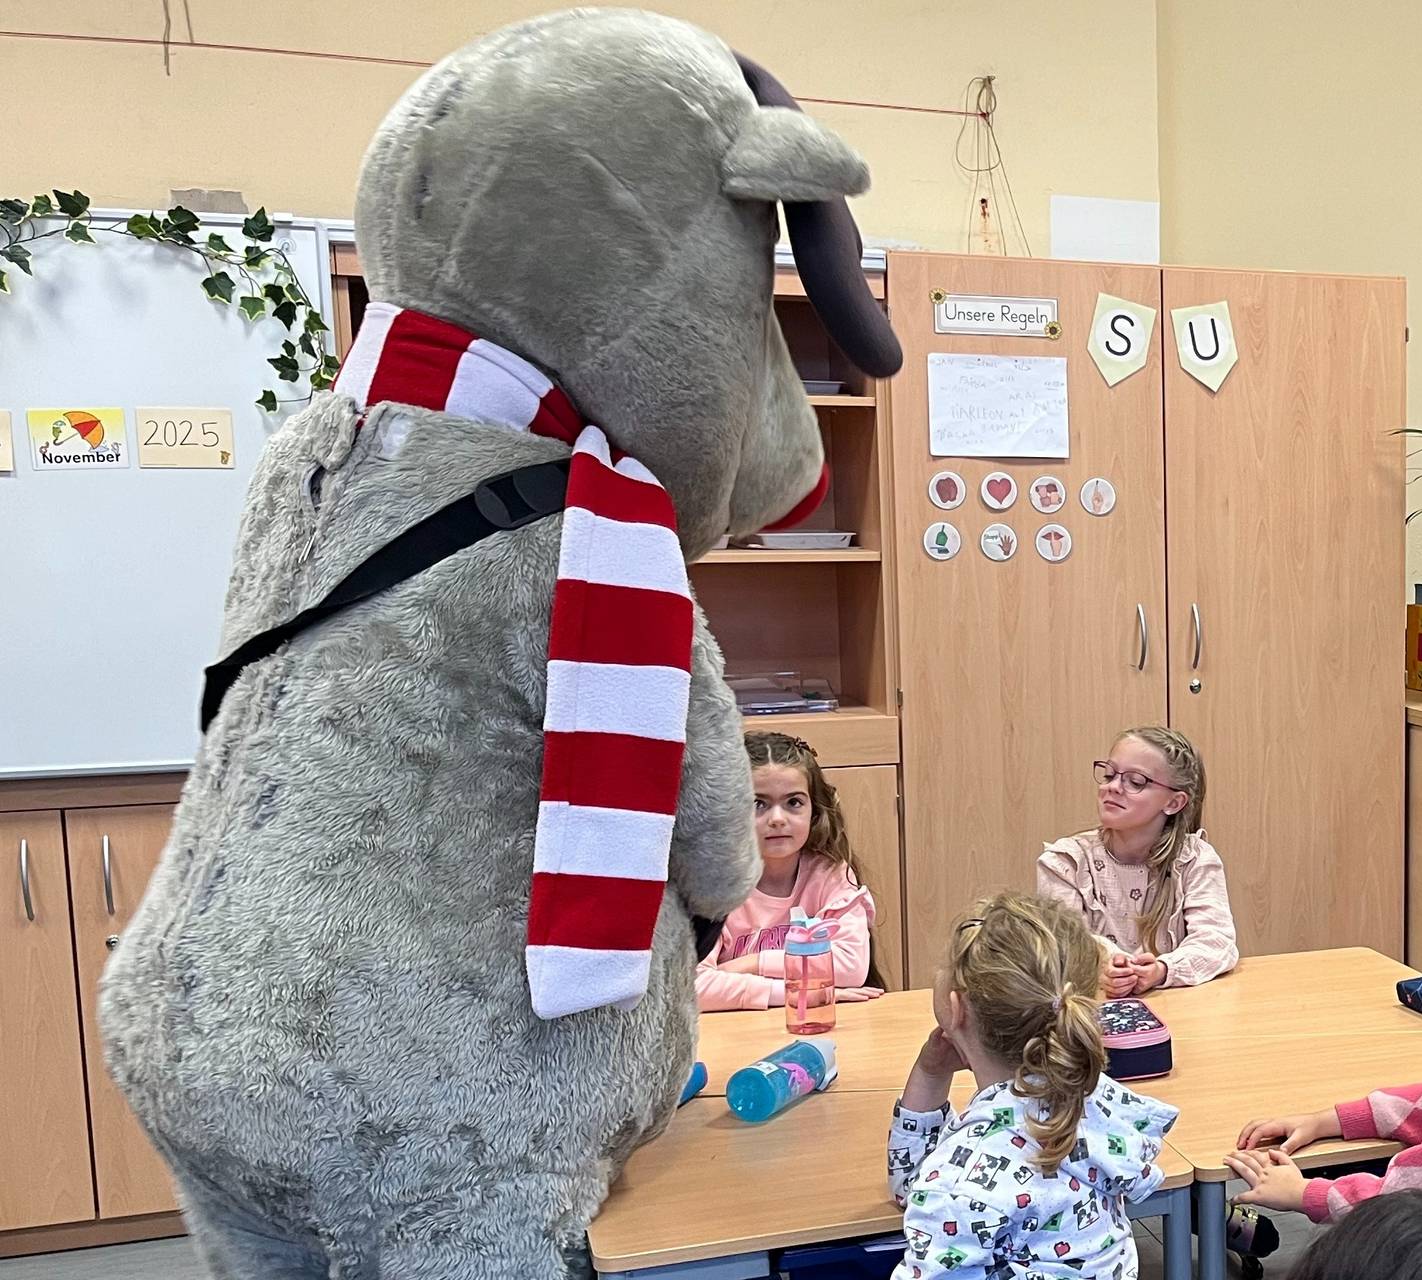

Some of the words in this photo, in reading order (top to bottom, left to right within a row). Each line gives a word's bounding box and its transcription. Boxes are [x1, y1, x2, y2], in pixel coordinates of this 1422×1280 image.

[945, 303, 995, 321] Unsere
[1001, 305, 1048, 330] Regeln
[143, 420, 219, 447] 2025
[42, 451, 121, 465] November
